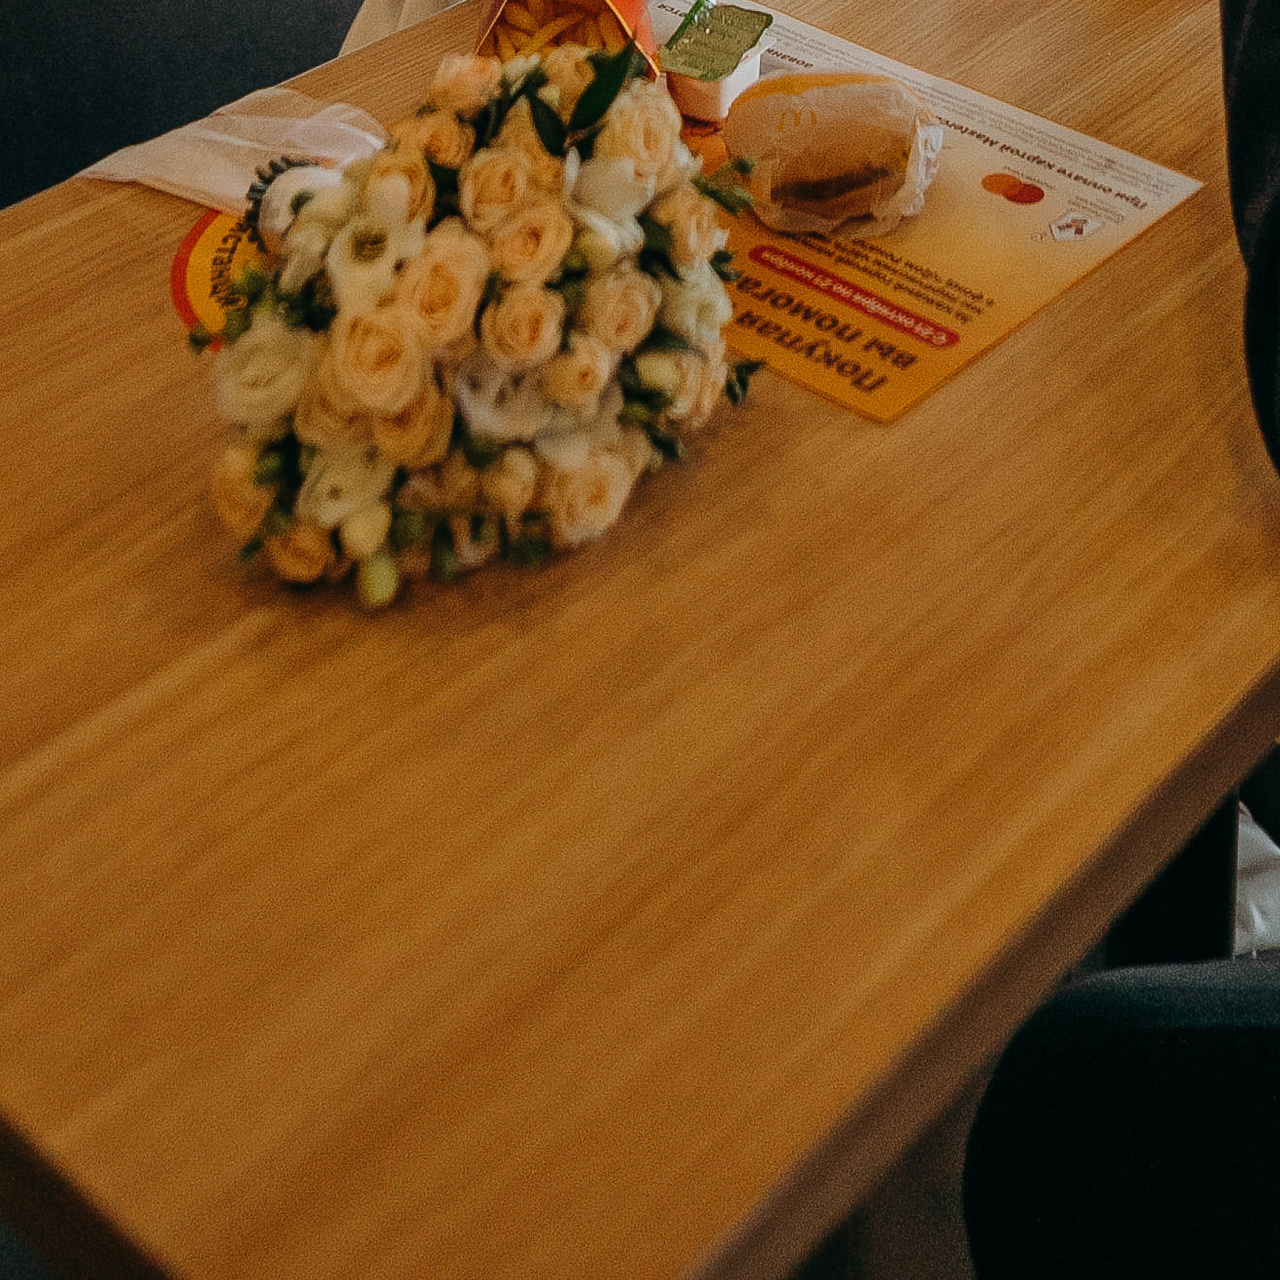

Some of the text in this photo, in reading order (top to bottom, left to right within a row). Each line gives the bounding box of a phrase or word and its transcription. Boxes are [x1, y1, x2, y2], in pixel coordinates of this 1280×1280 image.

[936, 115, 999, 147] Masterc
[736, 276, 919, 370] вы помога
[736, 311, 888, 393] Покупая
